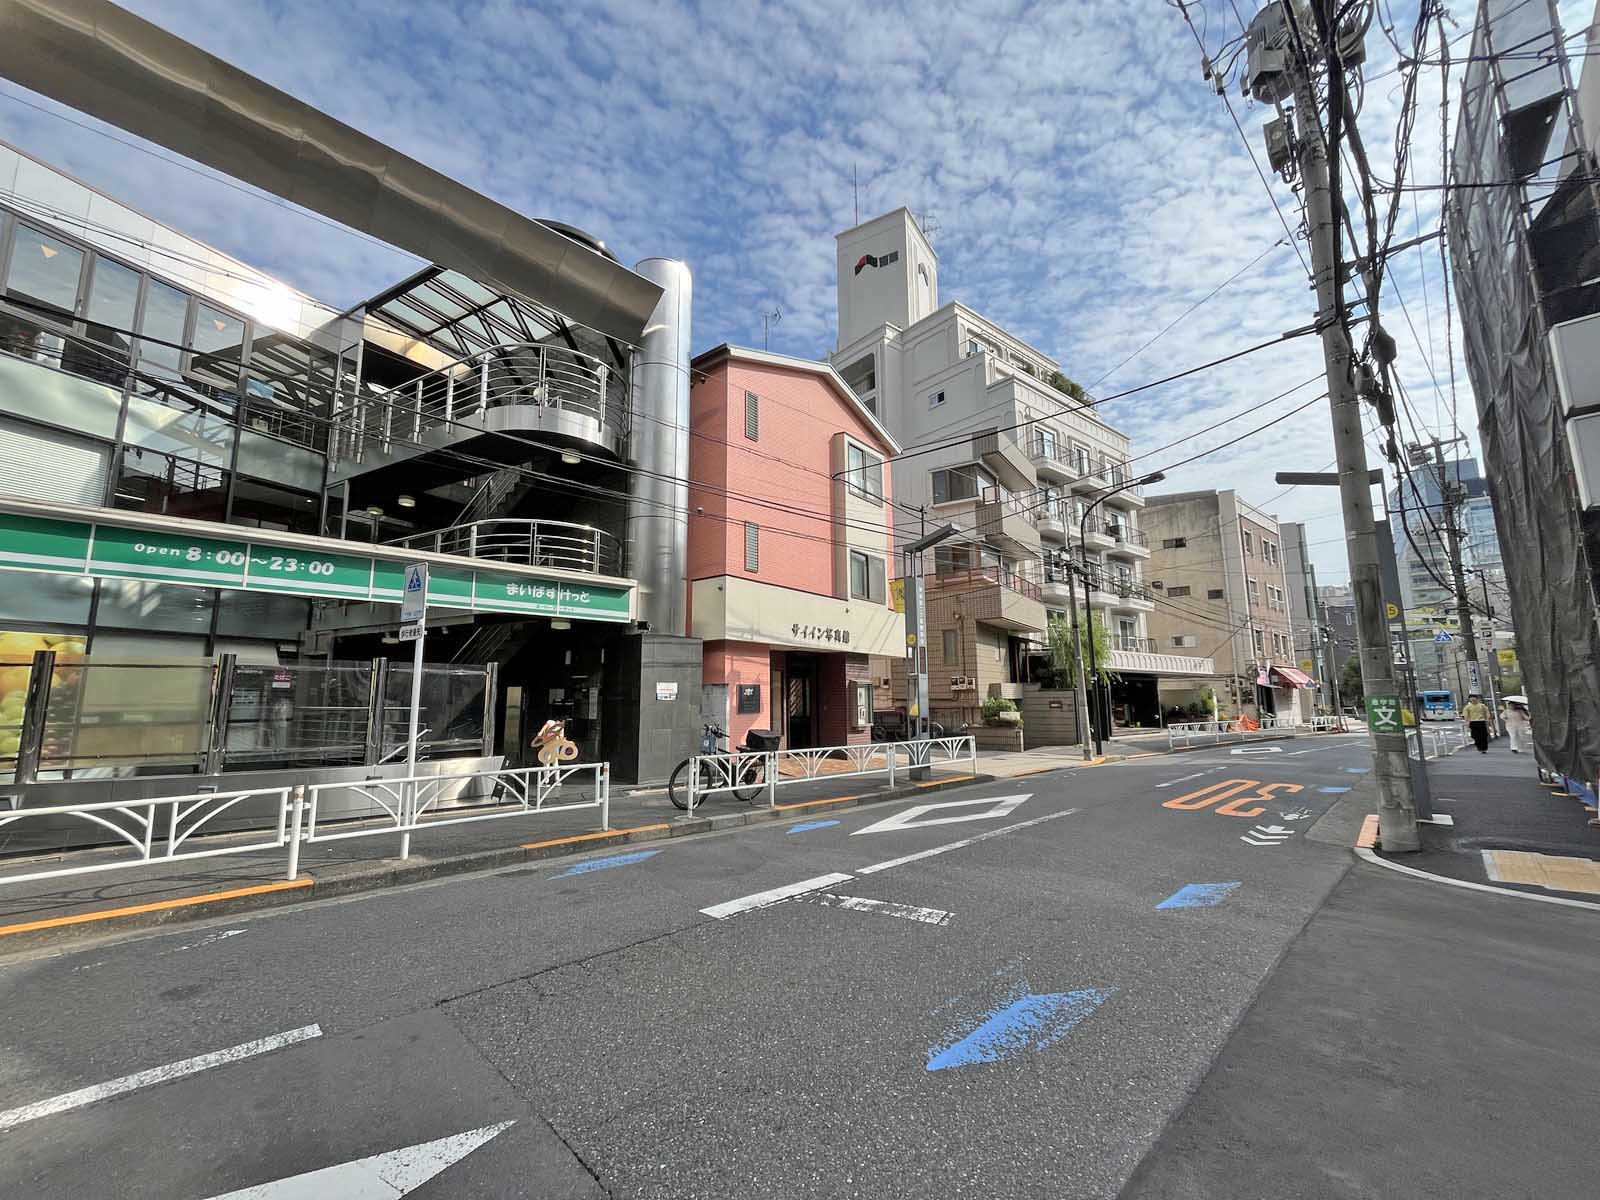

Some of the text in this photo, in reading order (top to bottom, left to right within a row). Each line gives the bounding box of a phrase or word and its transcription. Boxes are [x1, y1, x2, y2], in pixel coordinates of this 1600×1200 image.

[134, 543, 180, 556] open
[506, 583, 591, 603] まいばすけっと
[1373, 706, 1398, 726] 文
[1161, 778, 1304, 818] 30
